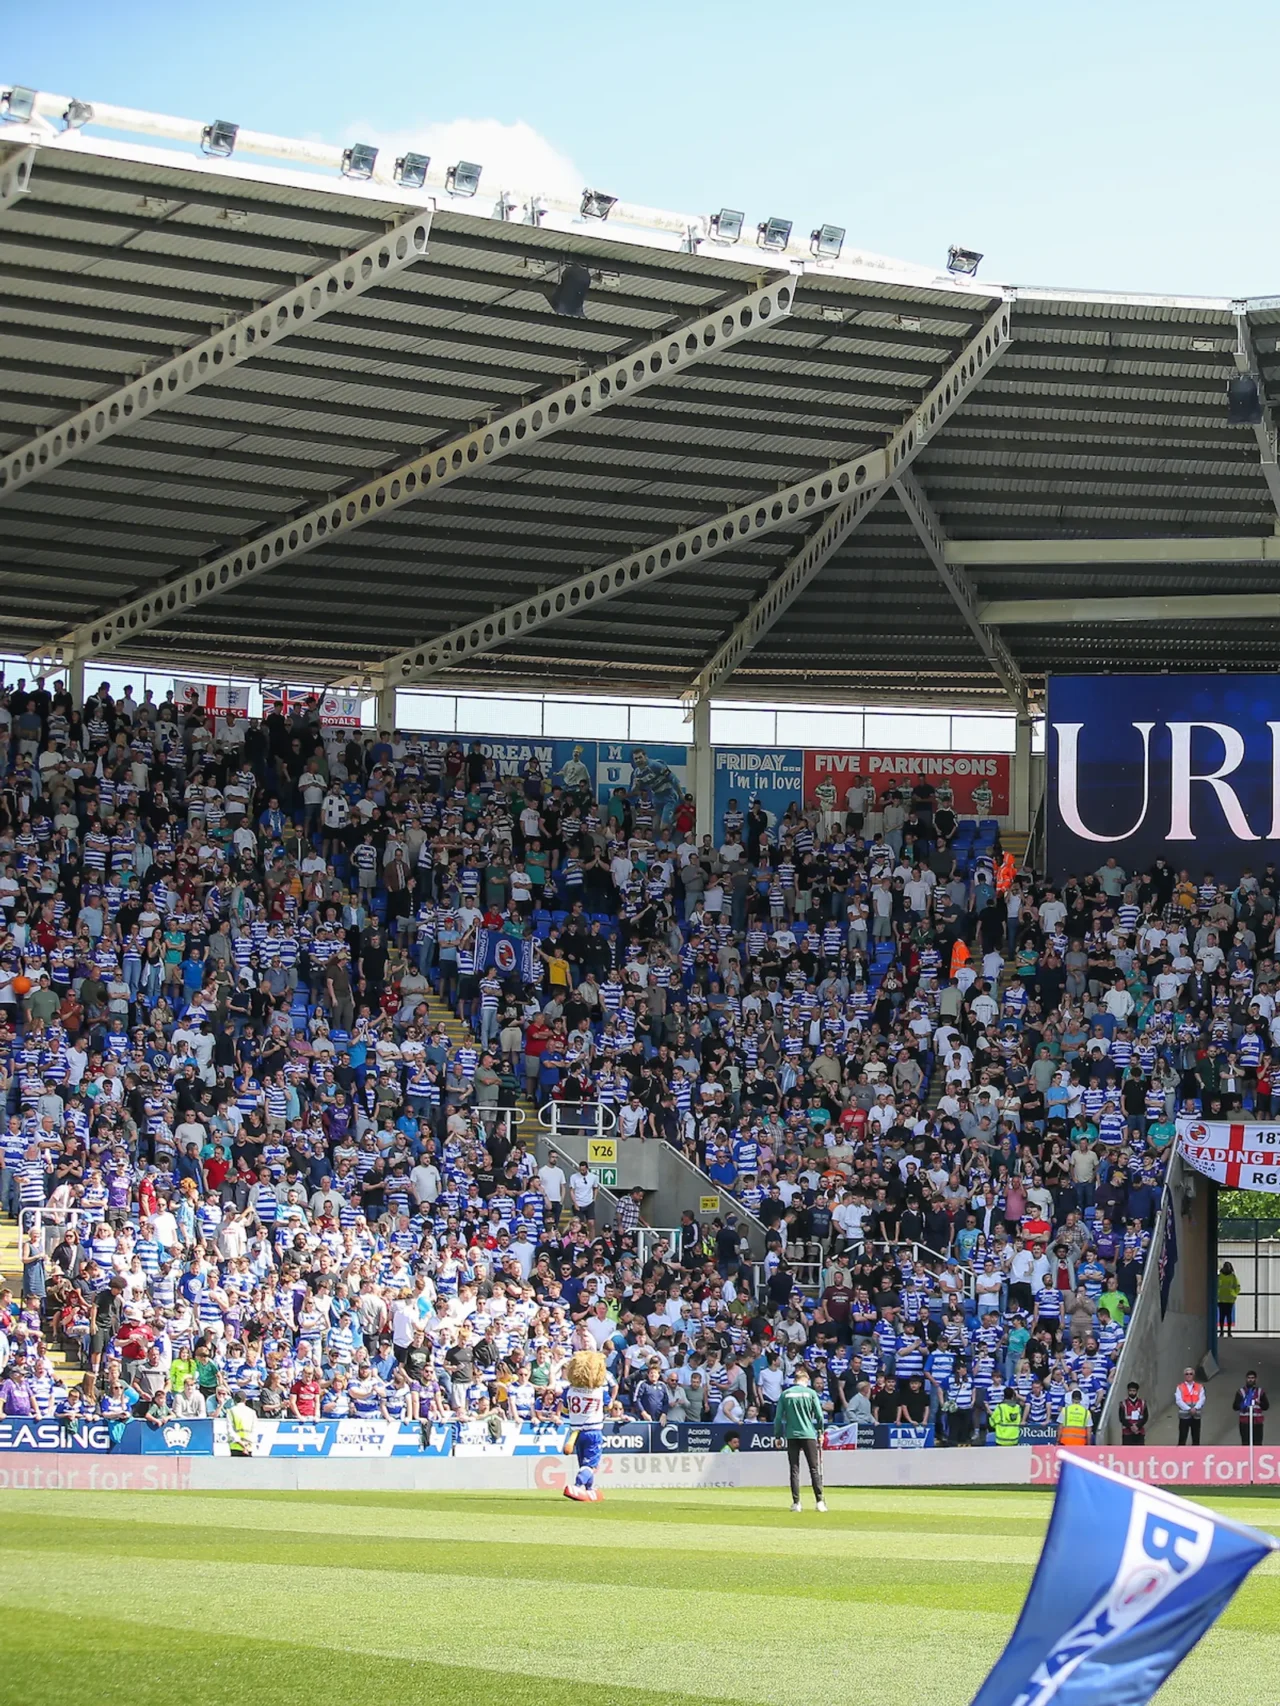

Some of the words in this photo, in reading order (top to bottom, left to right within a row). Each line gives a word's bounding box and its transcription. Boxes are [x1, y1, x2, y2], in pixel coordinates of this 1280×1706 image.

[322, 717, 355, 726] ROYALS
[480, 745, 552, 762] DREAM
[716, 753, 801, 771] FRIDAY...
[815, 755, 860, 773] FIVE
[869, 758, 997, 776] PARKINSONS
[755, 772, 768, 789] in
[772, 772, 801, 790] love
[592, 1145, 613, 1157] Y26
[688, 1428, 711, 1436] Acronis
[601, 1434, 643, 1449] cronis
[688, 1437, 712, 1446] Delivery
[620, 1455, 706, 1473] SURVEY
[1202, 1453, 1249, 1480] for
[88, 1463, 132, 1489] for
